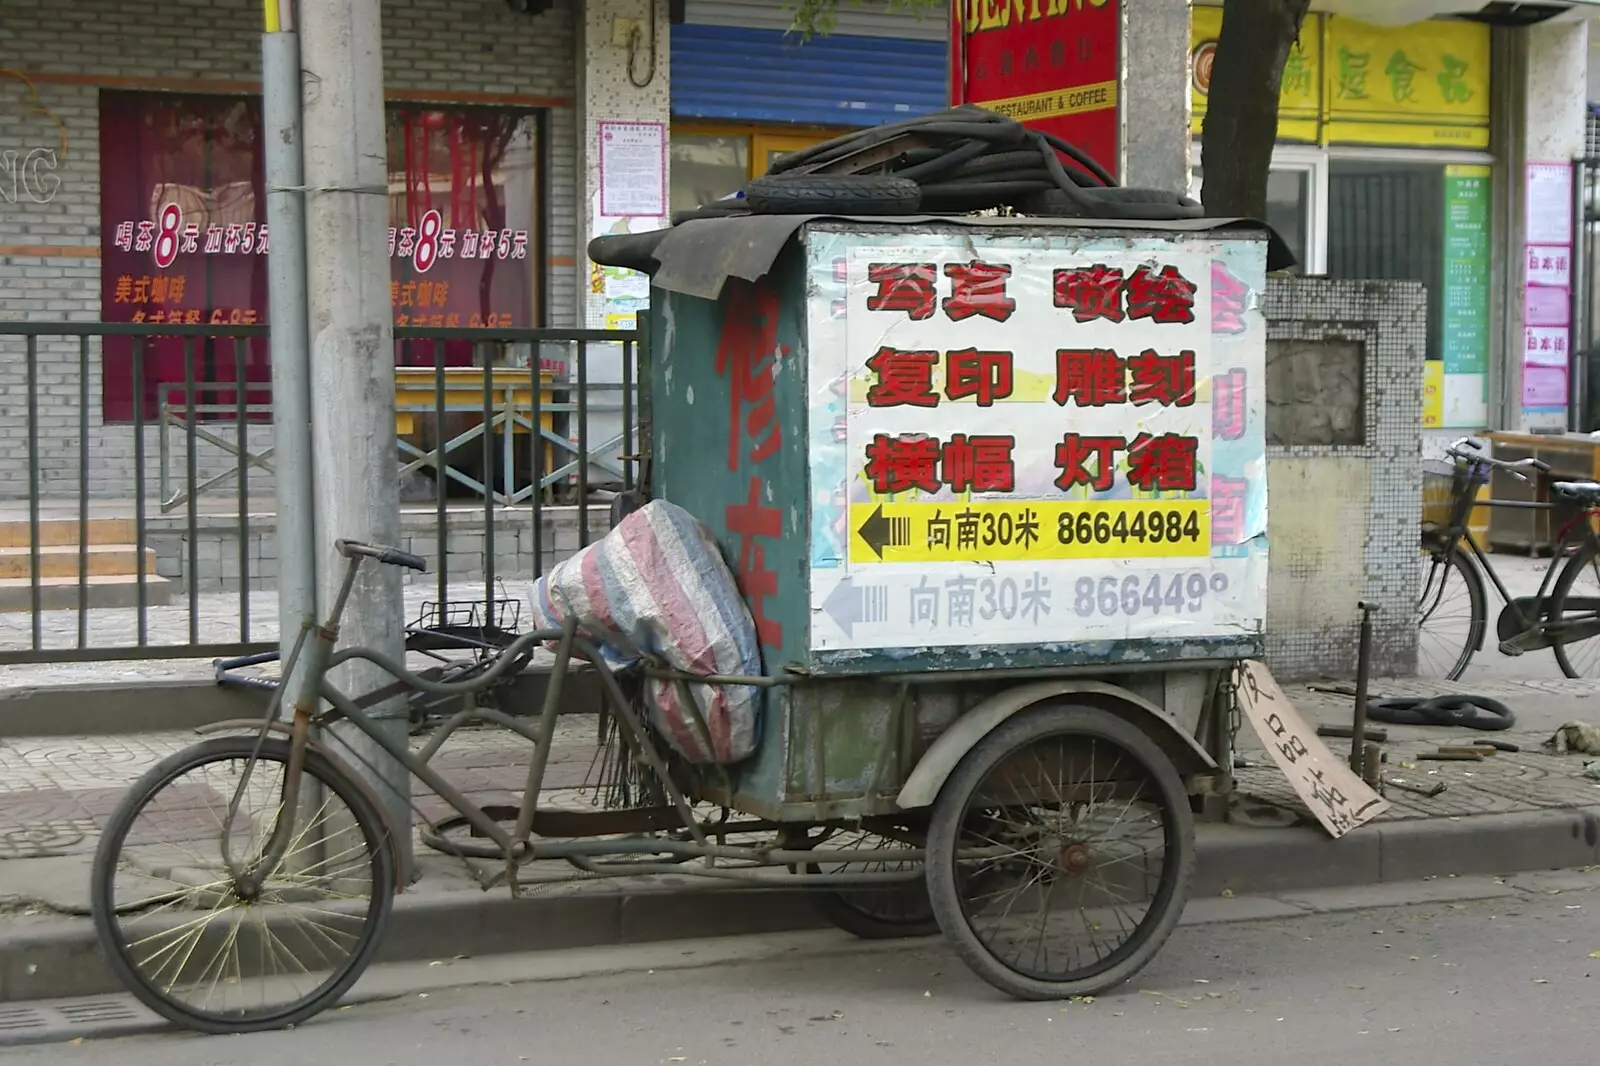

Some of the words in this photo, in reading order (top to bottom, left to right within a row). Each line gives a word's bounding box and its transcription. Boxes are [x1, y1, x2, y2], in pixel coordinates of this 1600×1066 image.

[1058, 95, 1064, 110] &
[1069, 88, 1107, 108] COFFEE
[115, 203, 199, 268] 喝茶8元
[460, 228, 528, 259] 加杯5元
[115, 275, 186, 304] 美式咖啡
[867, 260, 1016, 322] 写真
[1053, 264, 1197, 324] 喷绘
[866, 346, 1013, 407] 复印
[1053, 349, 1196, 407] 雕刻
[865, 433, 1016, 494] 横幅
[1054, 433, 1199, 491] 灯箱
[927, 507, 1040, 551] 向南30米
[1058, 510, 1200, 544] 86644984
[910, 572, 1051, 627] 向南30米
